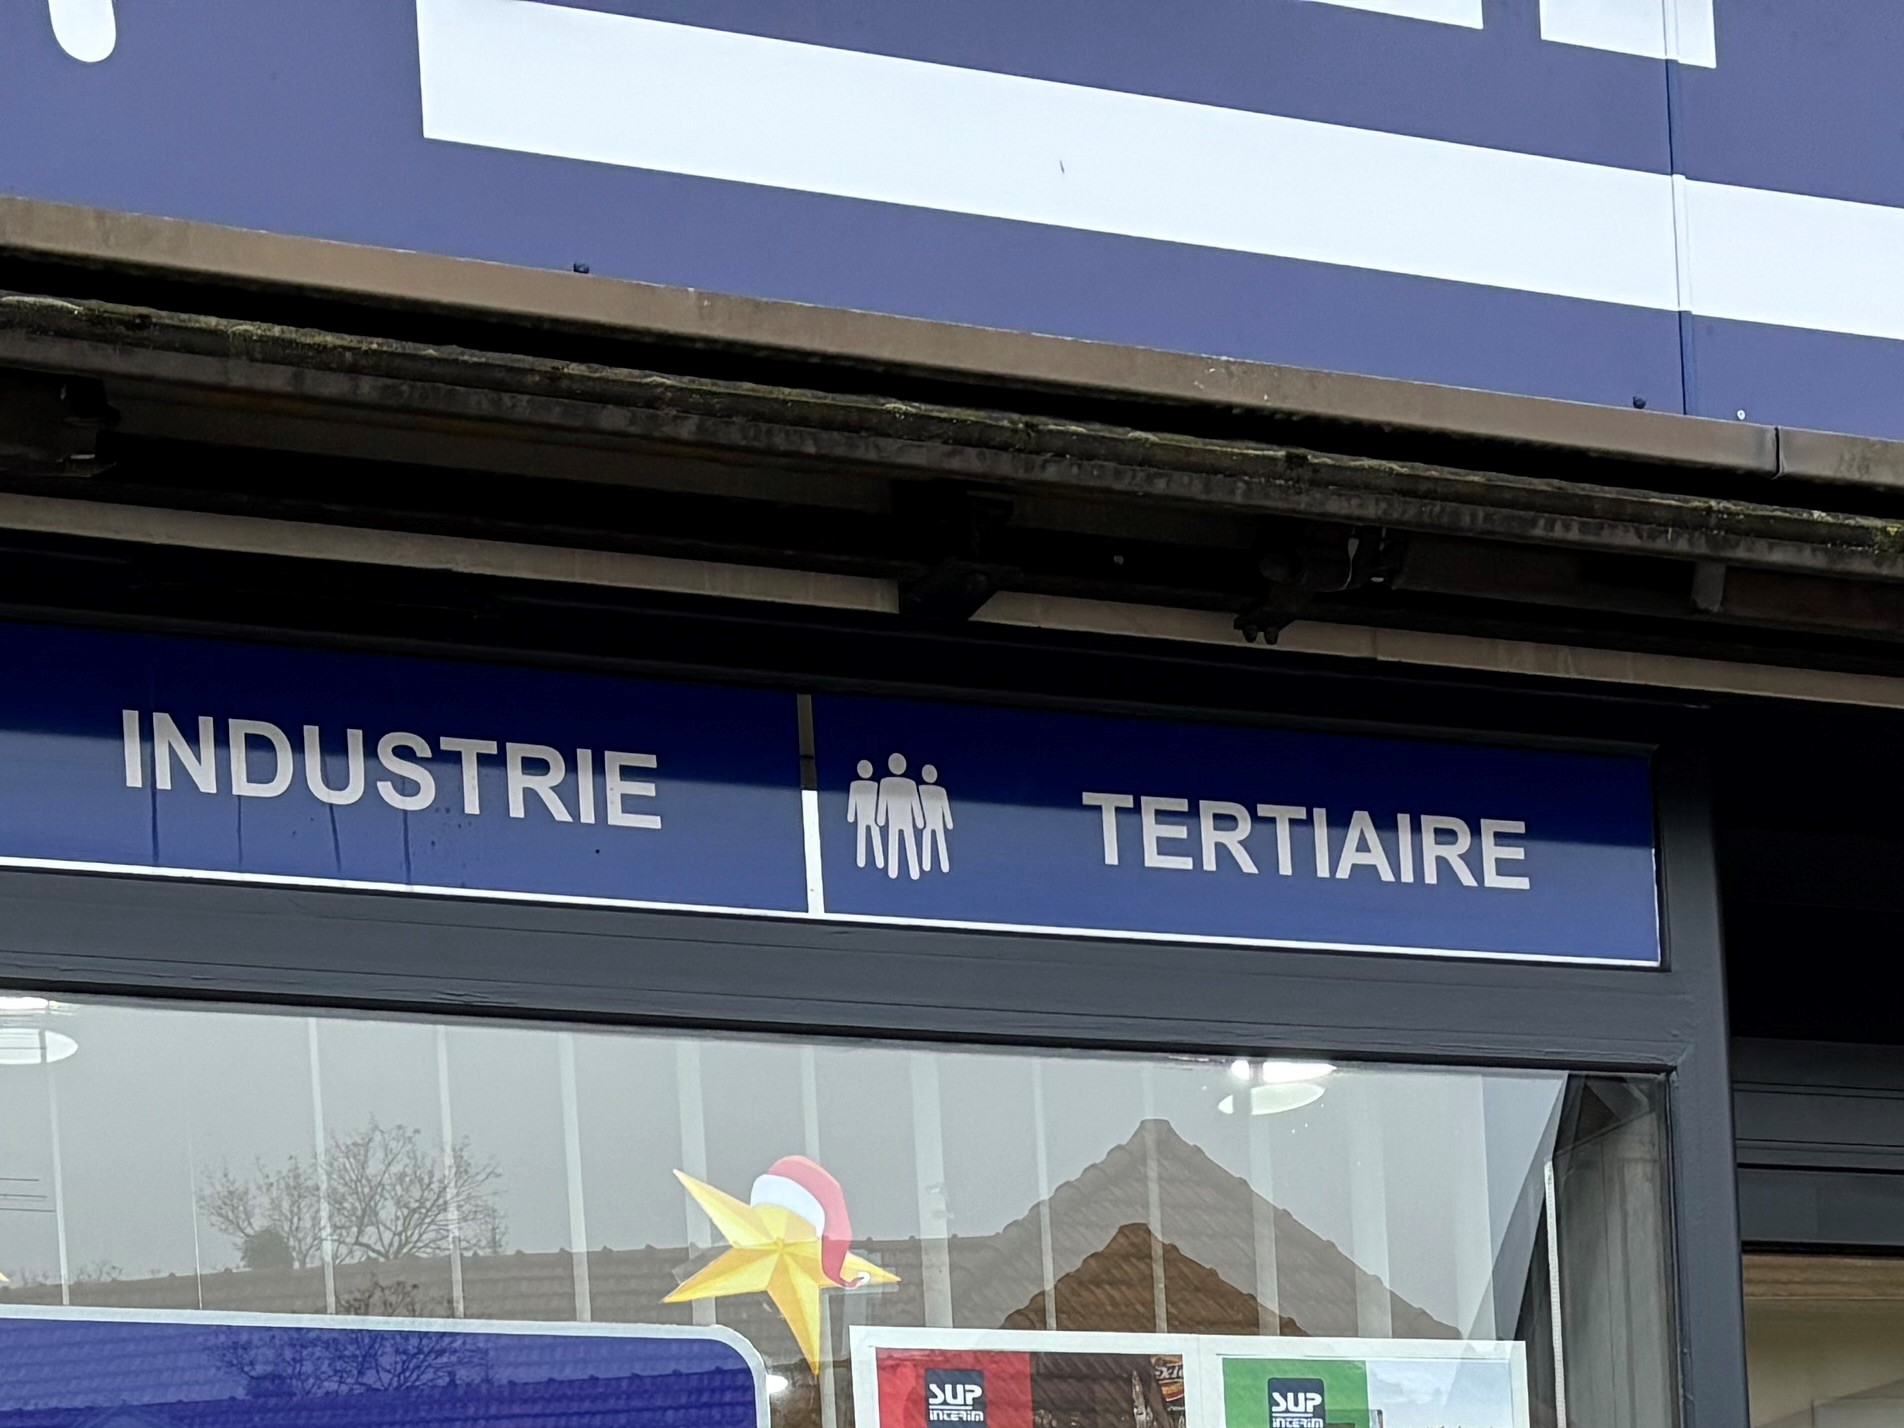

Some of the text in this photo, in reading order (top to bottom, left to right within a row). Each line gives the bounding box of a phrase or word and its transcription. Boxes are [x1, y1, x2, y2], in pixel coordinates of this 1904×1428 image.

[121, 708, 661, 829] INDUSTRIE
[1081, 790, 1530, 889] TERTIAIRE
[928, 1383, 983, 1405] SUP
[1271, 1392, 1322, 1412] SUP
